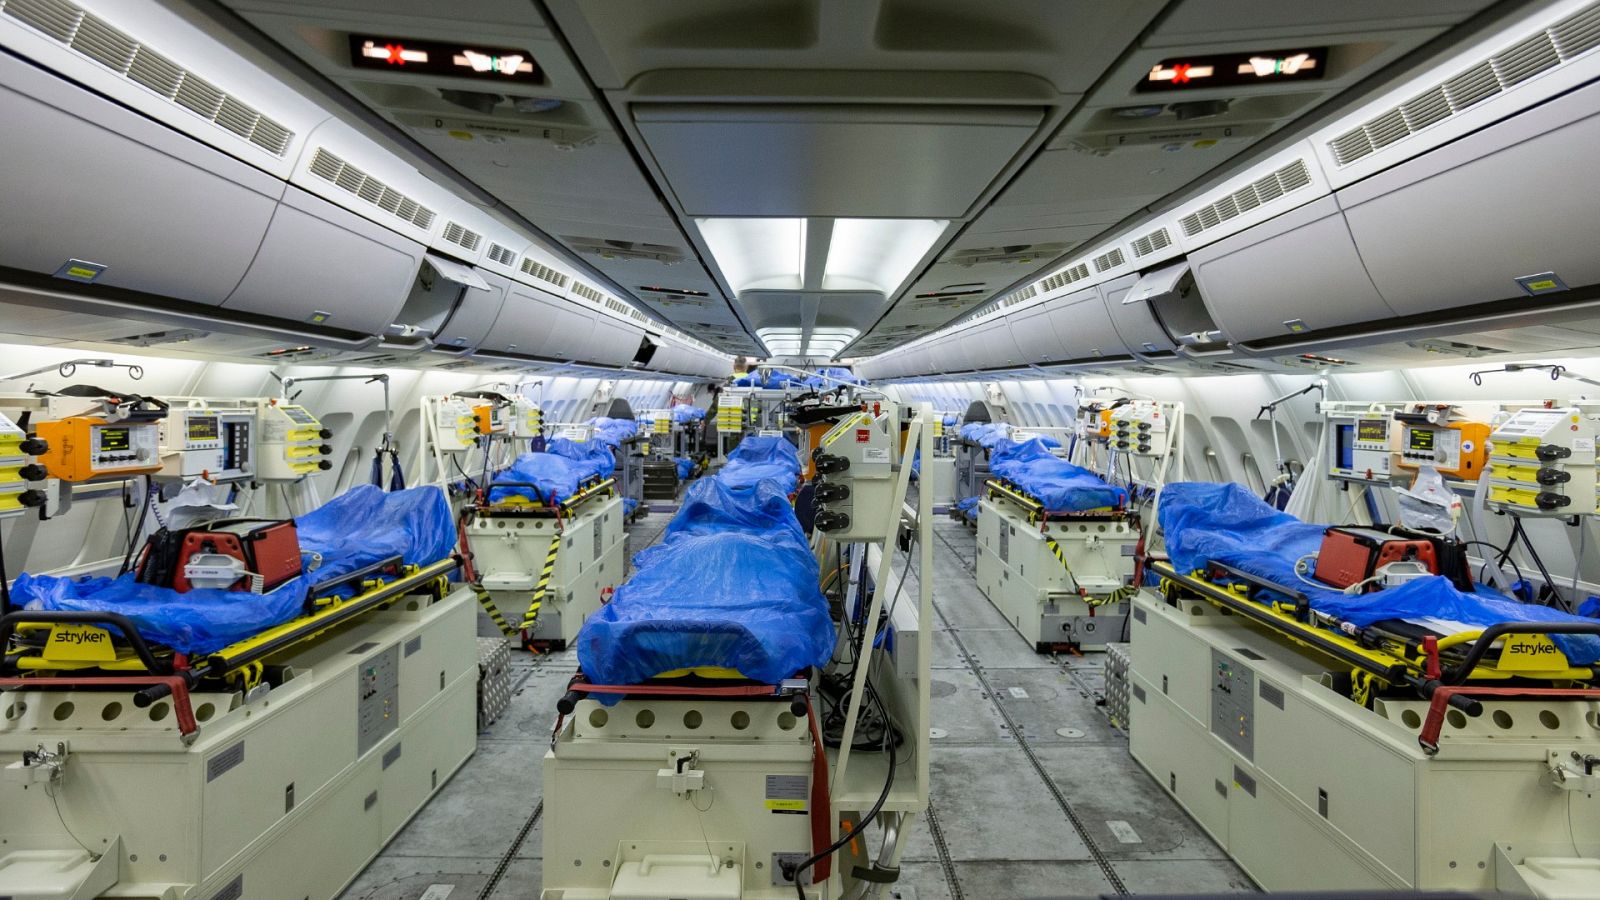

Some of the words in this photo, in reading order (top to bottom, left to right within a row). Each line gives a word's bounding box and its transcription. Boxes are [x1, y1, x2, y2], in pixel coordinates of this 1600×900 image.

[435, 119, 443, 128] D
[543, 129, 550, 138] E
[55, 630, 106, 645] stryker
